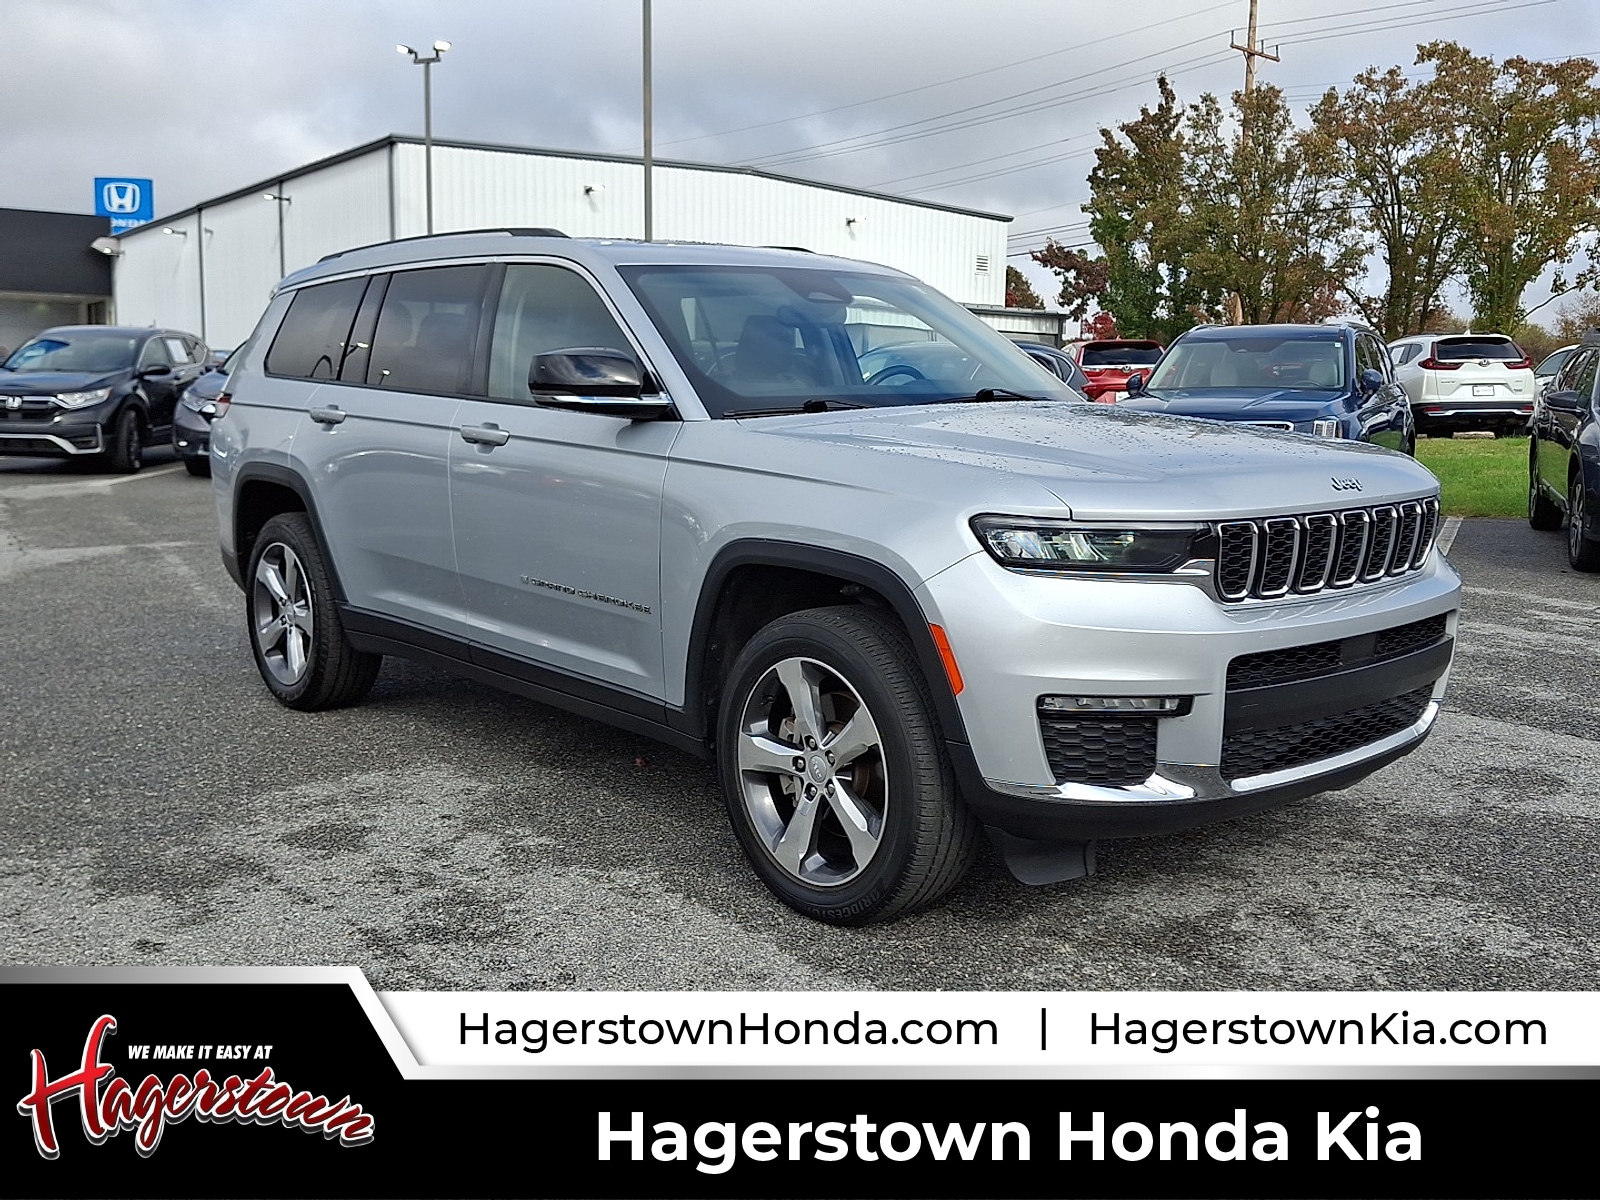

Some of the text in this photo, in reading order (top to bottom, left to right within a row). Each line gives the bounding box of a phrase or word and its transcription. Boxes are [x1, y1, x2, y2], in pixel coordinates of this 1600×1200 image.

[111, 218, 147, 228] ONDA
[1331, 476, 1363, 492] Jeep
[530, 577, 652, 615] GRAND CHEROKEE
[805, 888, 881, 919] BRIDGESTO
